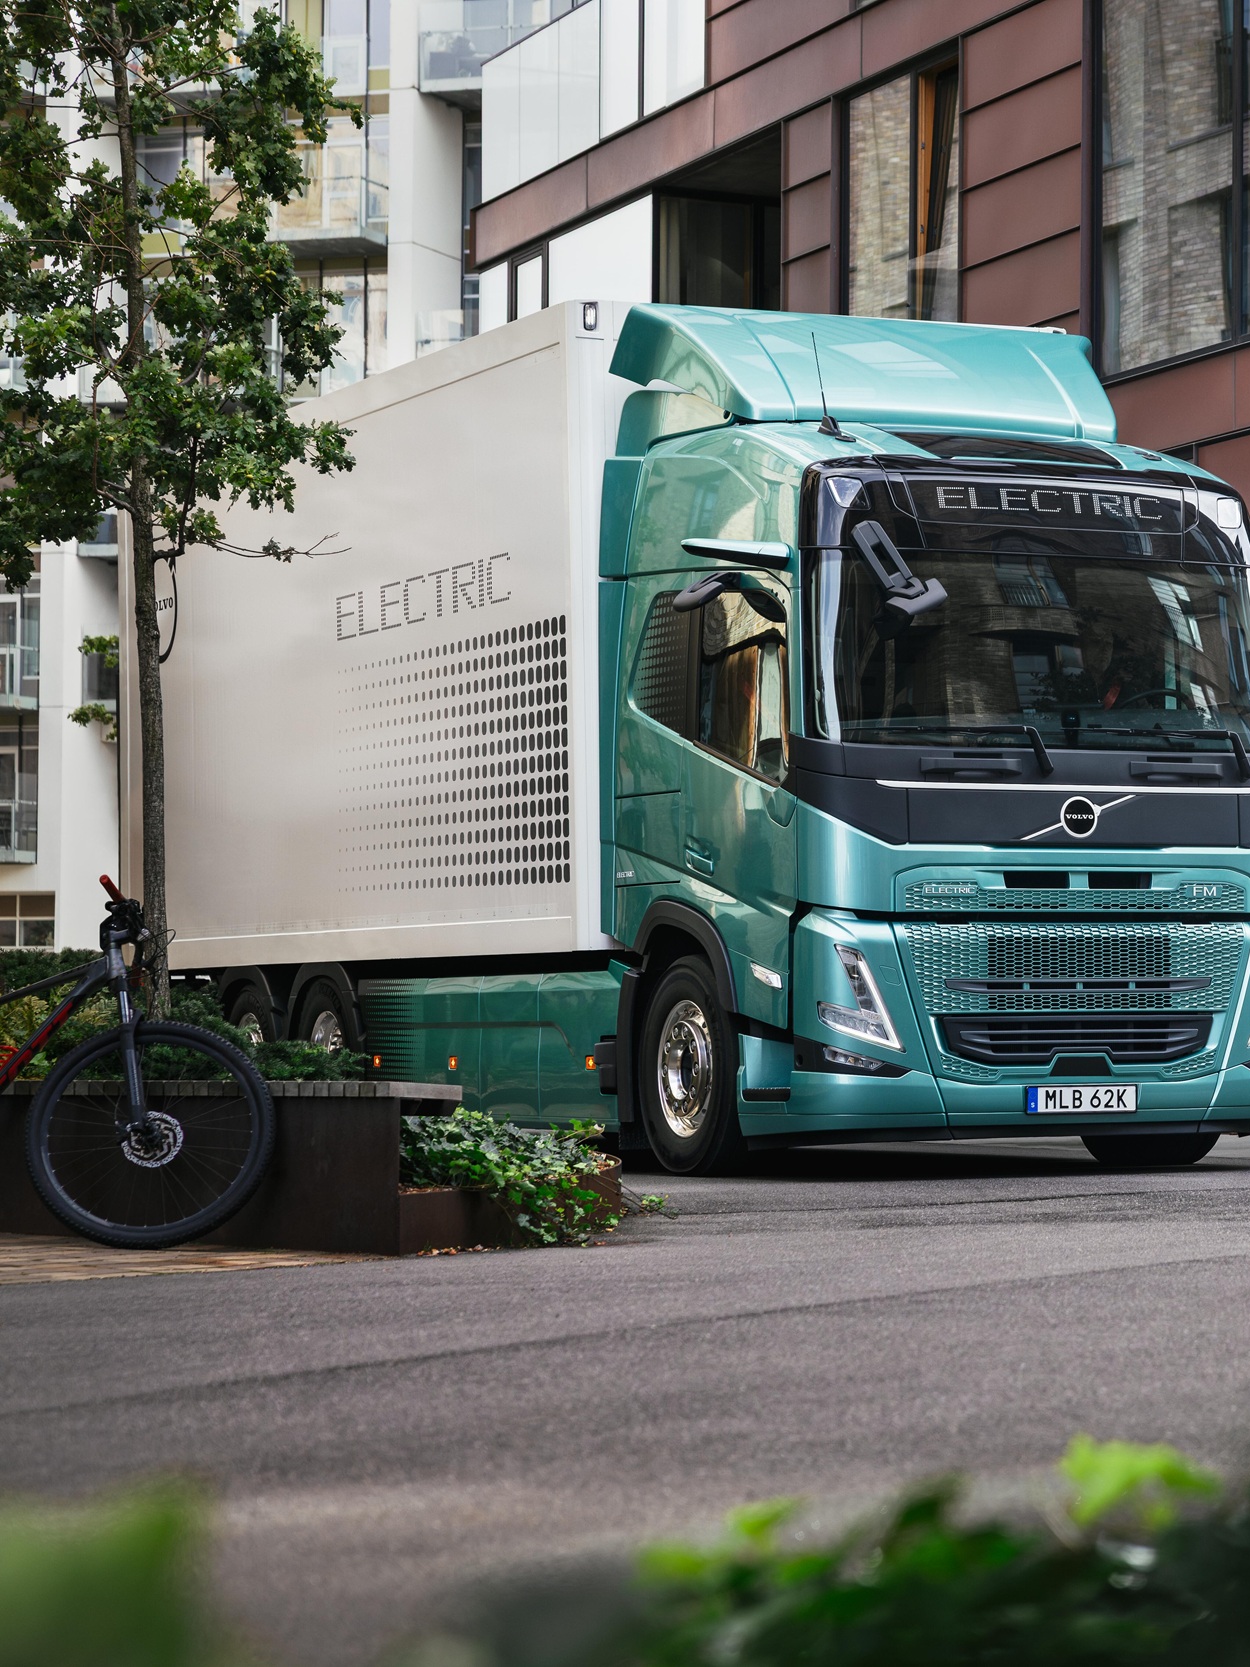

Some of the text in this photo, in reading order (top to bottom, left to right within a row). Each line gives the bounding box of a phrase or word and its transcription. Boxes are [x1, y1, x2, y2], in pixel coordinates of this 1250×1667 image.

[936, 486, 1163, 520] ELECTRIC
[155, 597, 174, 612] OLVO
[336, 552, 512, 641] ELECTRIC
[925, 886, 976, 895] ELECTRIC
[1193, 886, 1217, 897] FM
[1045, 1088, 1128, 1110] MLB 62K
